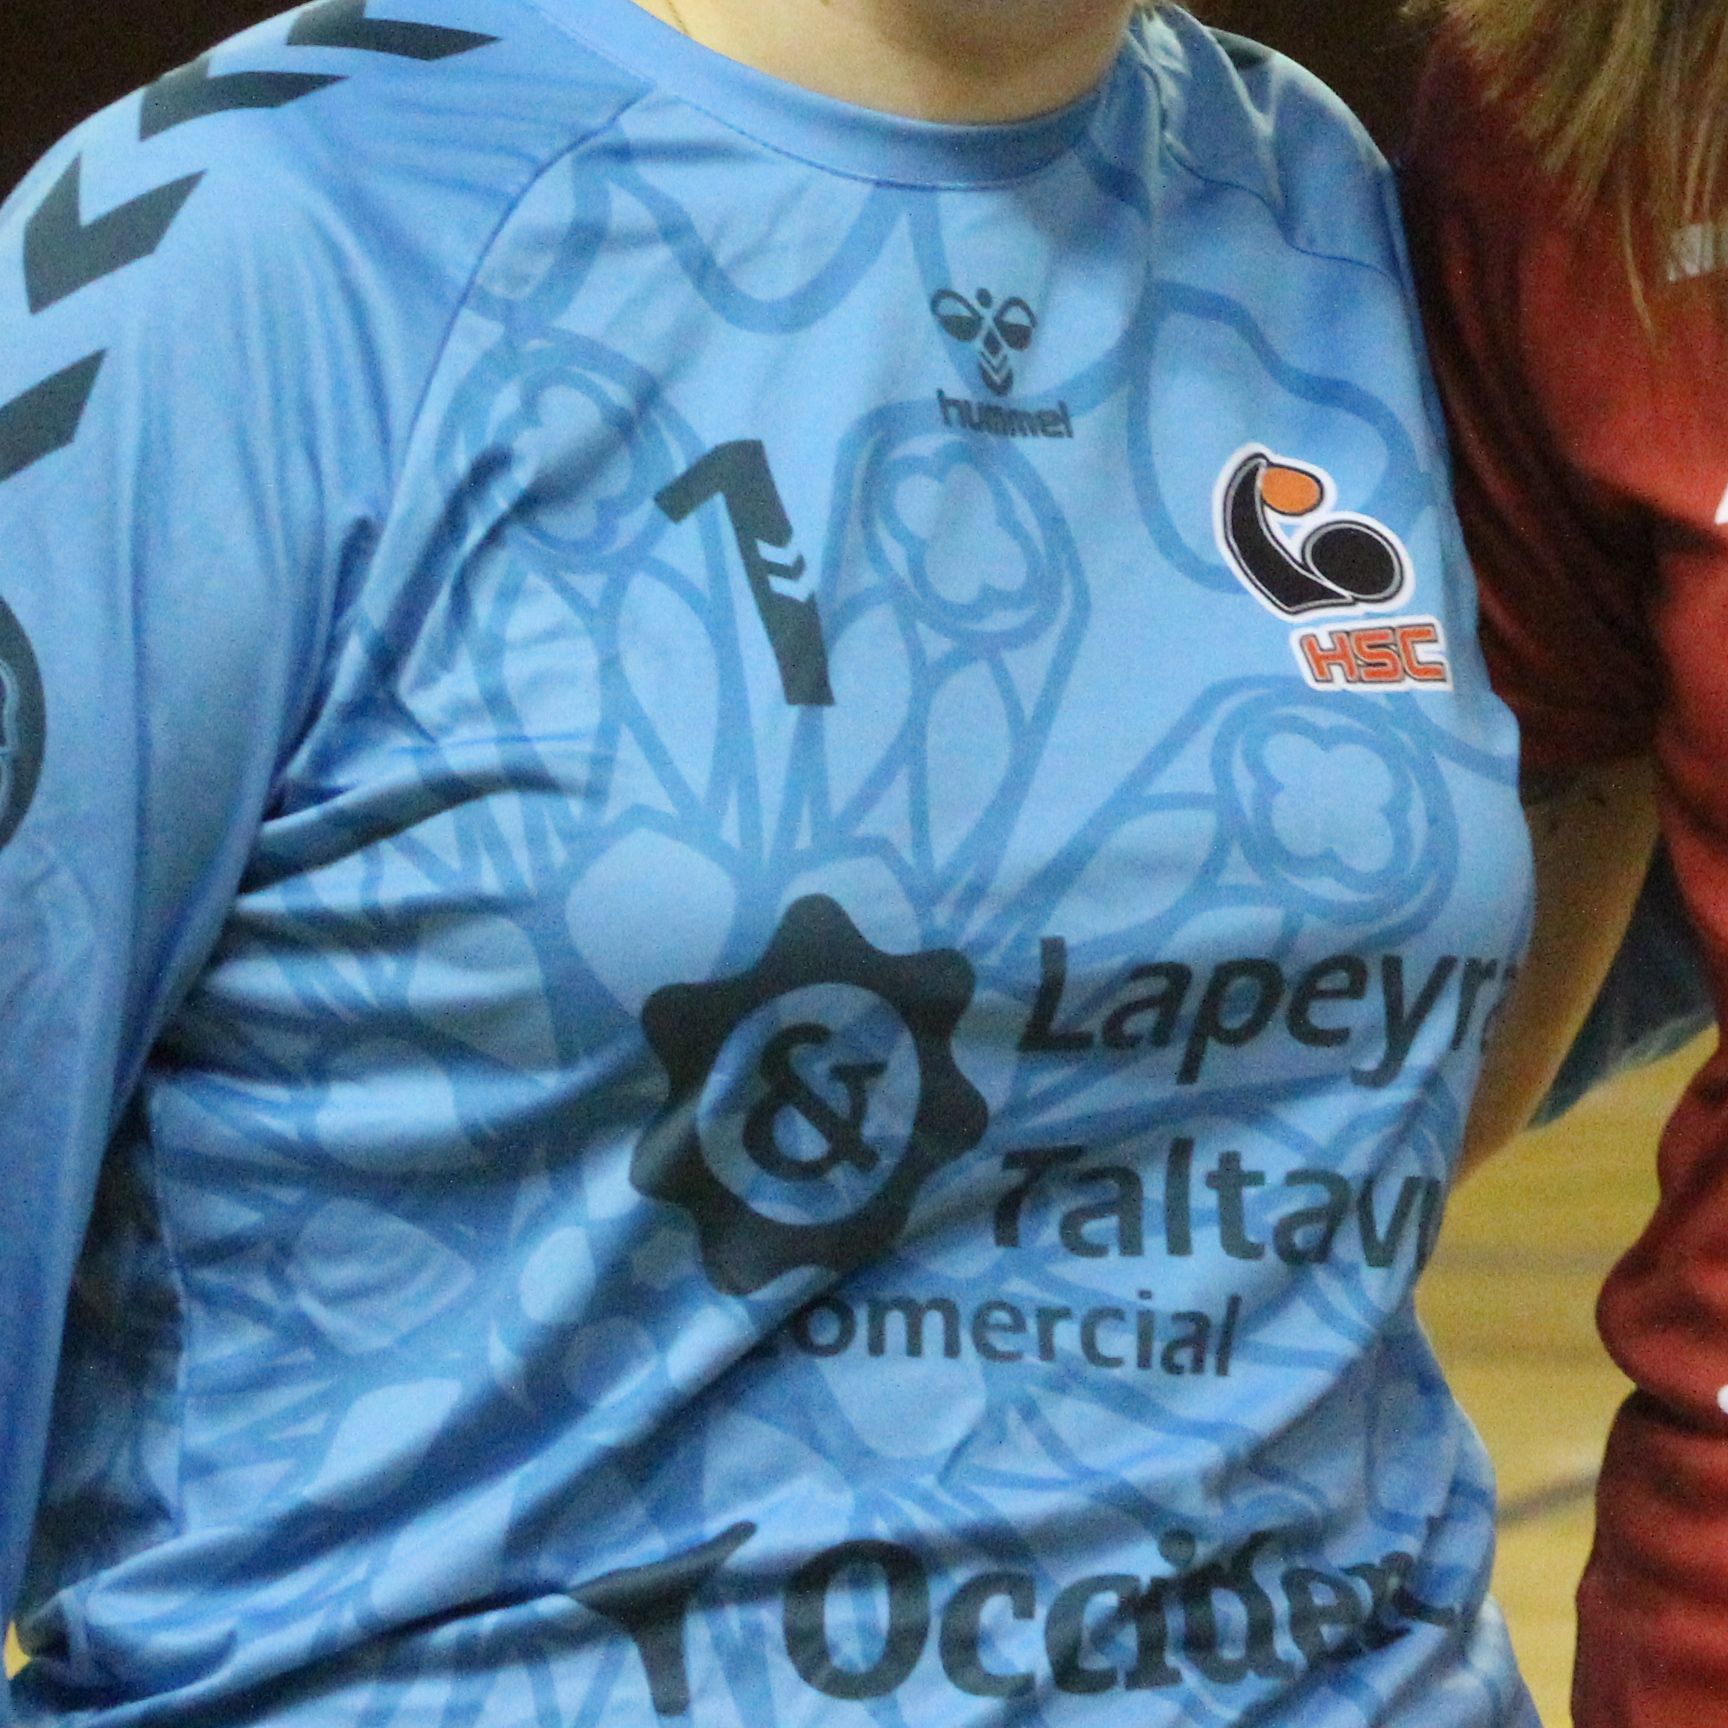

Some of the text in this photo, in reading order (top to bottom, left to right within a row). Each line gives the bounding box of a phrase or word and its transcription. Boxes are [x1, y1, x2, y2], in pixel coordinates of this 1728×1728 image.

[936, 388, 1074, 440] hummel
[654, 438, 836, 707] 1
[1302, 624, 1450, 686] HSC
